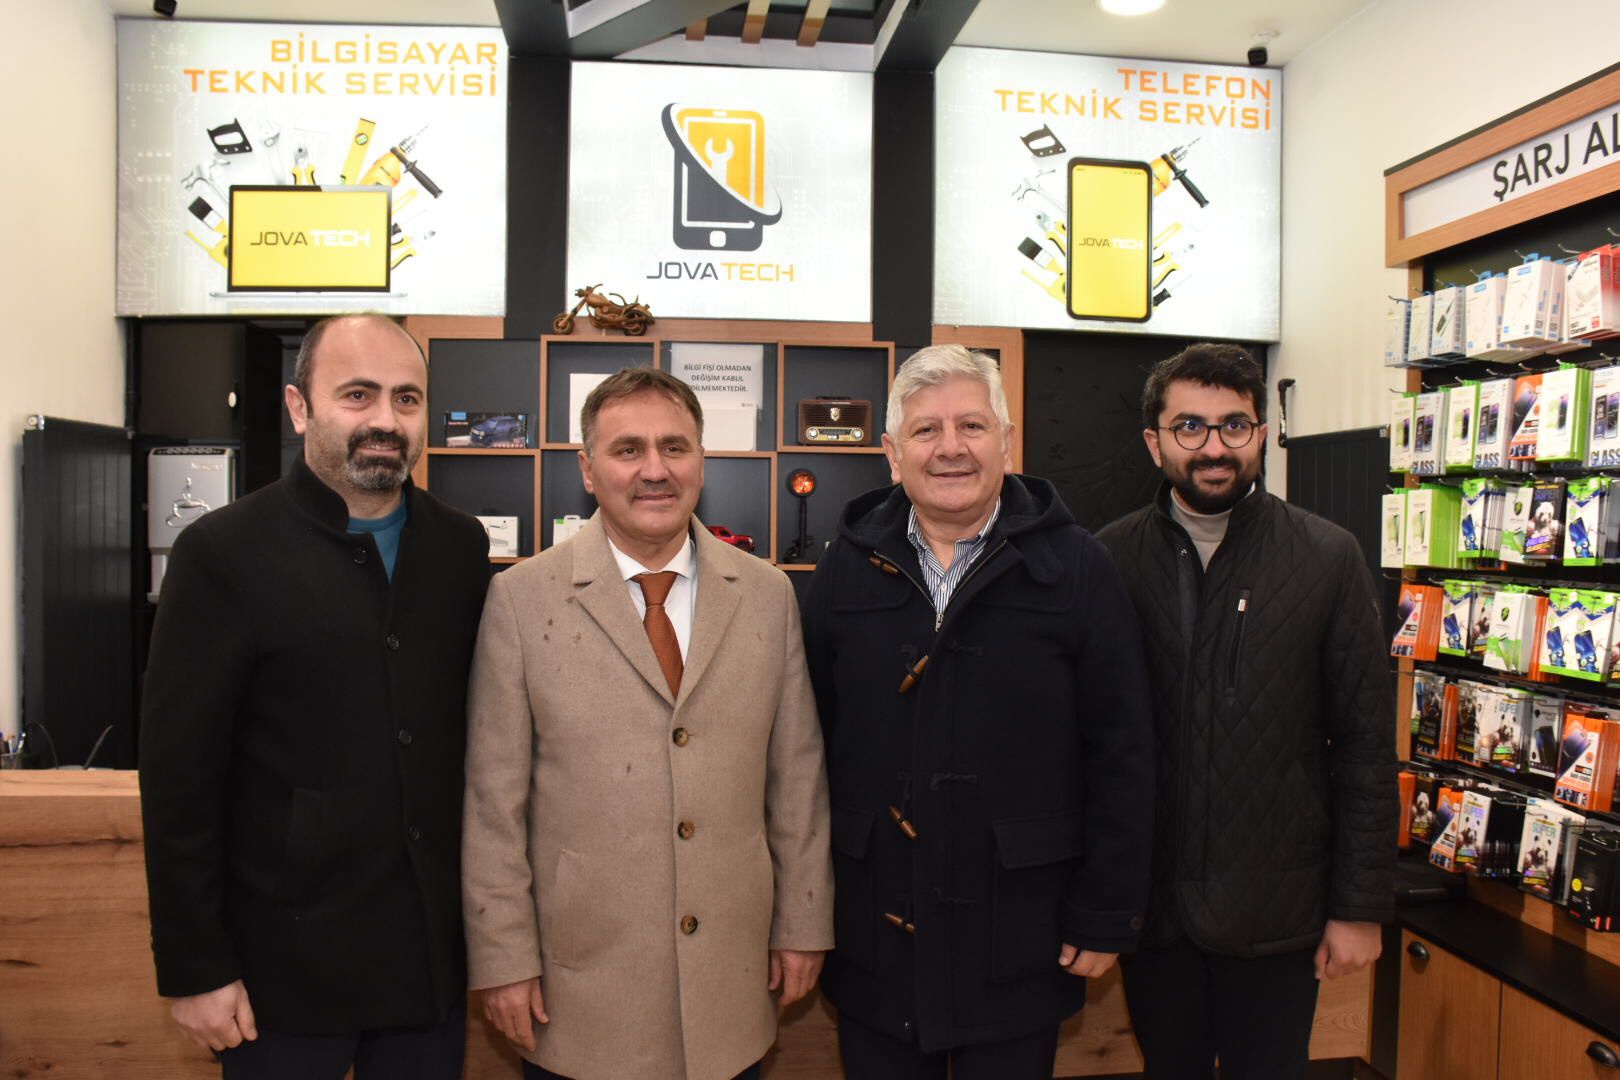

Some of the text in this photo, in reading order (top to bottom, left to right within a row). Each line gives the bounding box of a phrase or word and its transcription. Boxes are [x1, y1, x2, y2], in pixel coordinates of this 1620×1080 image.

[270, 31, 498, 65] BİLGİSAYAR
[183, 63, 497, 97] TEKNİK SERVİSİ
[1117, 67, 1272, 100] TELEFON
[994, 88, 1272, 131] TEKNİK SERVİSİ
[1492, 132, 1570, 202] ŞARJ
[683, 363, 752, 373] BİLGİ FİŞİ OLMADAN
[691, 373, 720, 383] DEĞİŞİM
[690, 384, 748, 392] DİLMEMEKTEDİR.
[1411, 460, 1435, 474] GLASS
[1475, 452, 1500, 471] GLASS
